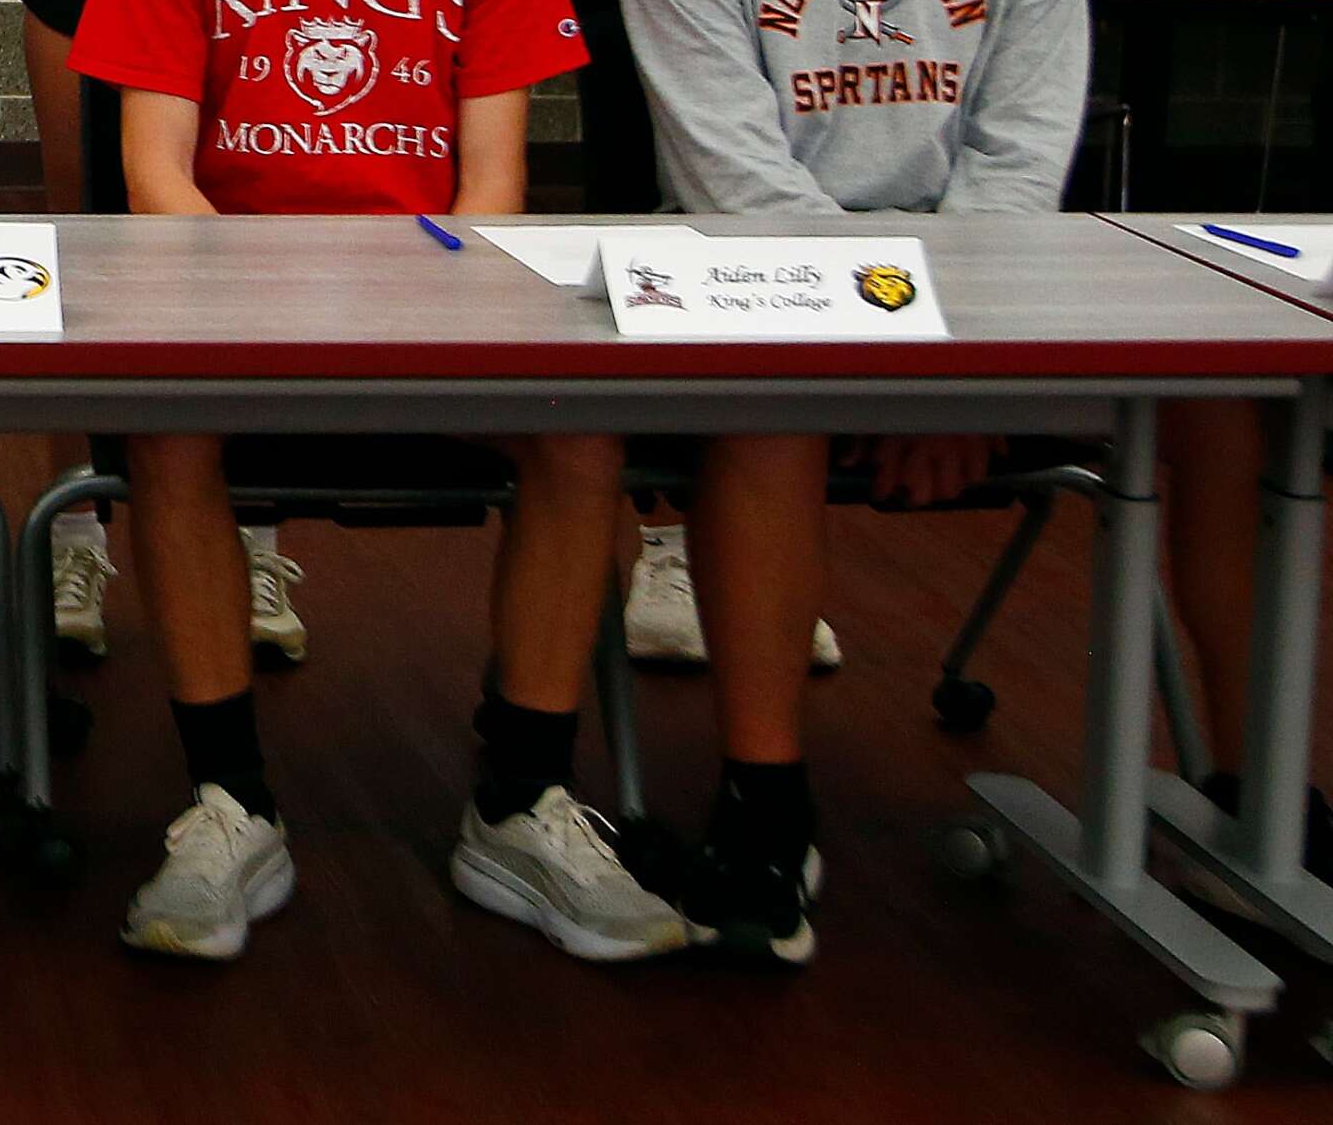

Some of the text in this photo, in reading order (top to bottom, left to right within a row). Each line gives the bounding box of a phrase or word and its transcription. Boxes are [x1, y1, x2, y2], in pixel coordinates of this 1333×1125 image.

[238, 55, 432, 86] 19 46
[217, 119, 451, 159] MONARCHS
[770, 293, 831, 312] College
